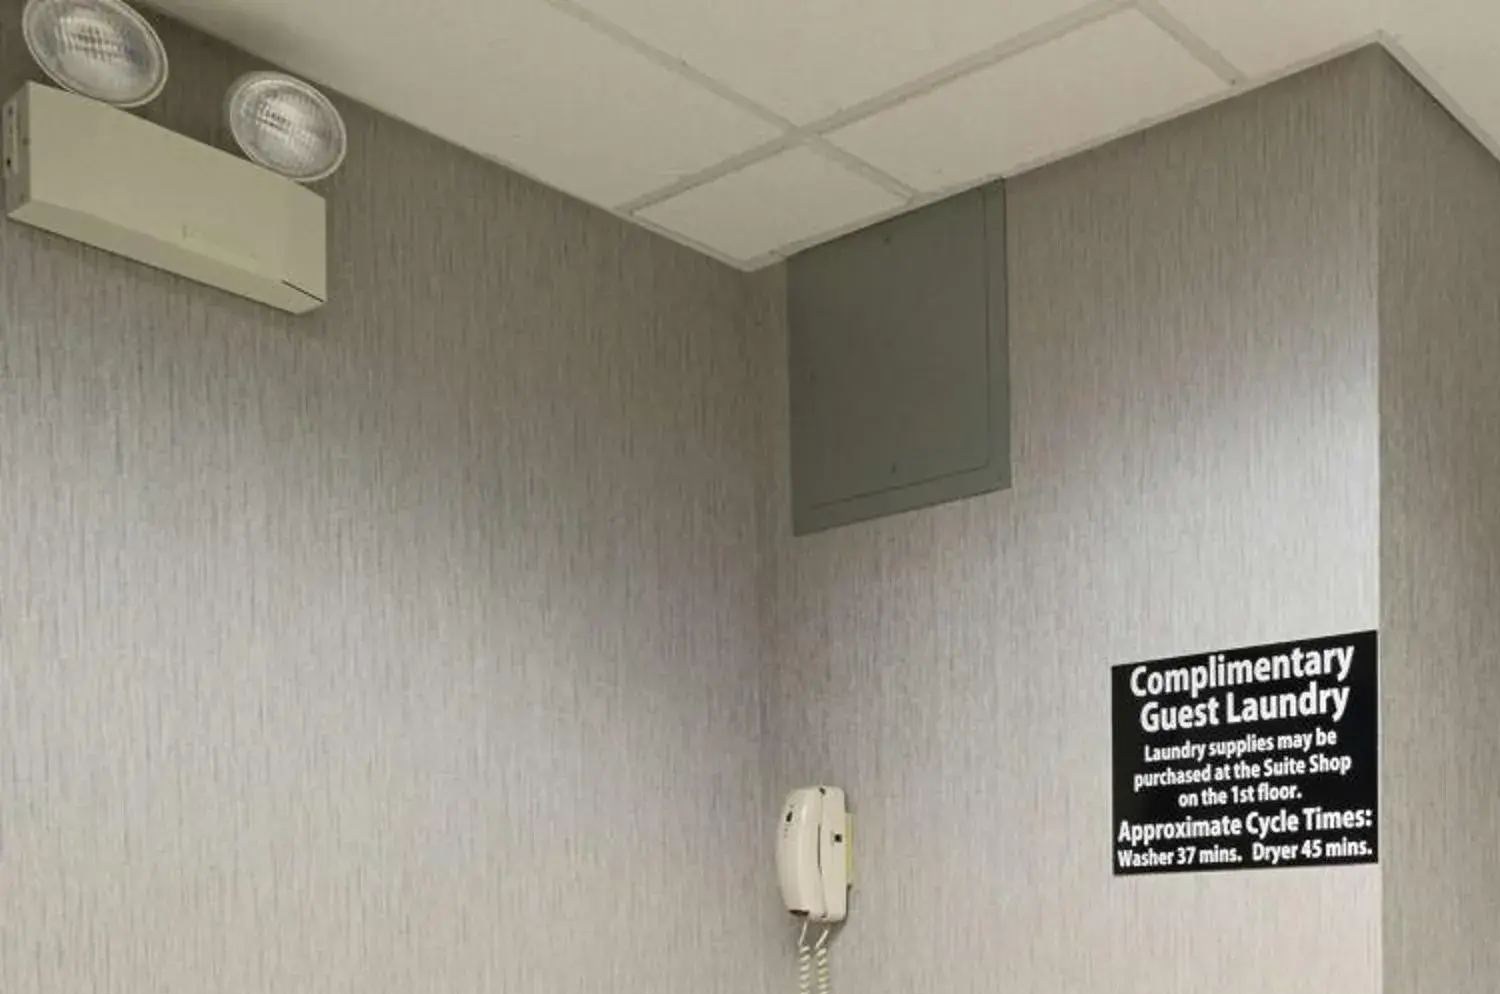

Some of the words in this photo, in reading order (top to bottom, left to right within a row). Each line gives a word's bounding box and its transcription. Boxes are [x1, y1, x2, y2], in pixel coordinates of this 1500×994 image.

[1130, 646, 1354, 698] Complimentary
[1140, 696, 1219, 732] Guest
[1226, 681, 1350, 723] Laundry
[1145, 741, 1205, 762] Laundry
[1208, 734, 1274, 758] supplies
[1278, 732, 1312, 751] may
[1316, 727, 1337, 746] be
[1134, 765, 1210, 792] purchased
[1215, 765, 1230, 781] at
[1234, 761, 1260, 779] the
[1264, 757, 1305, 778] Suite
[1309, 753, 1352, 775] Shop
[1178, 792, 1198, 807] on
[1202, 787, 1227, 806] the
[1231, 785, 1254, 804] 1st
[1258, 782, 1302, 801] floor.
[1118, 815, 1242, 846] Approximate
[1245, 809, 1299, 839] Cycle
[1303, 807, 1372, 831] Times:
[1118, 847, 1173, 867] Washer
[1177, 848, 1196, 864] 37
[1199, 845, 1243, 863] mins.
[1252, 842, 1298, 864] Dryer
[1301, 840, 1322, 858] 45
[1326, 837, 1373, 857] mins.
